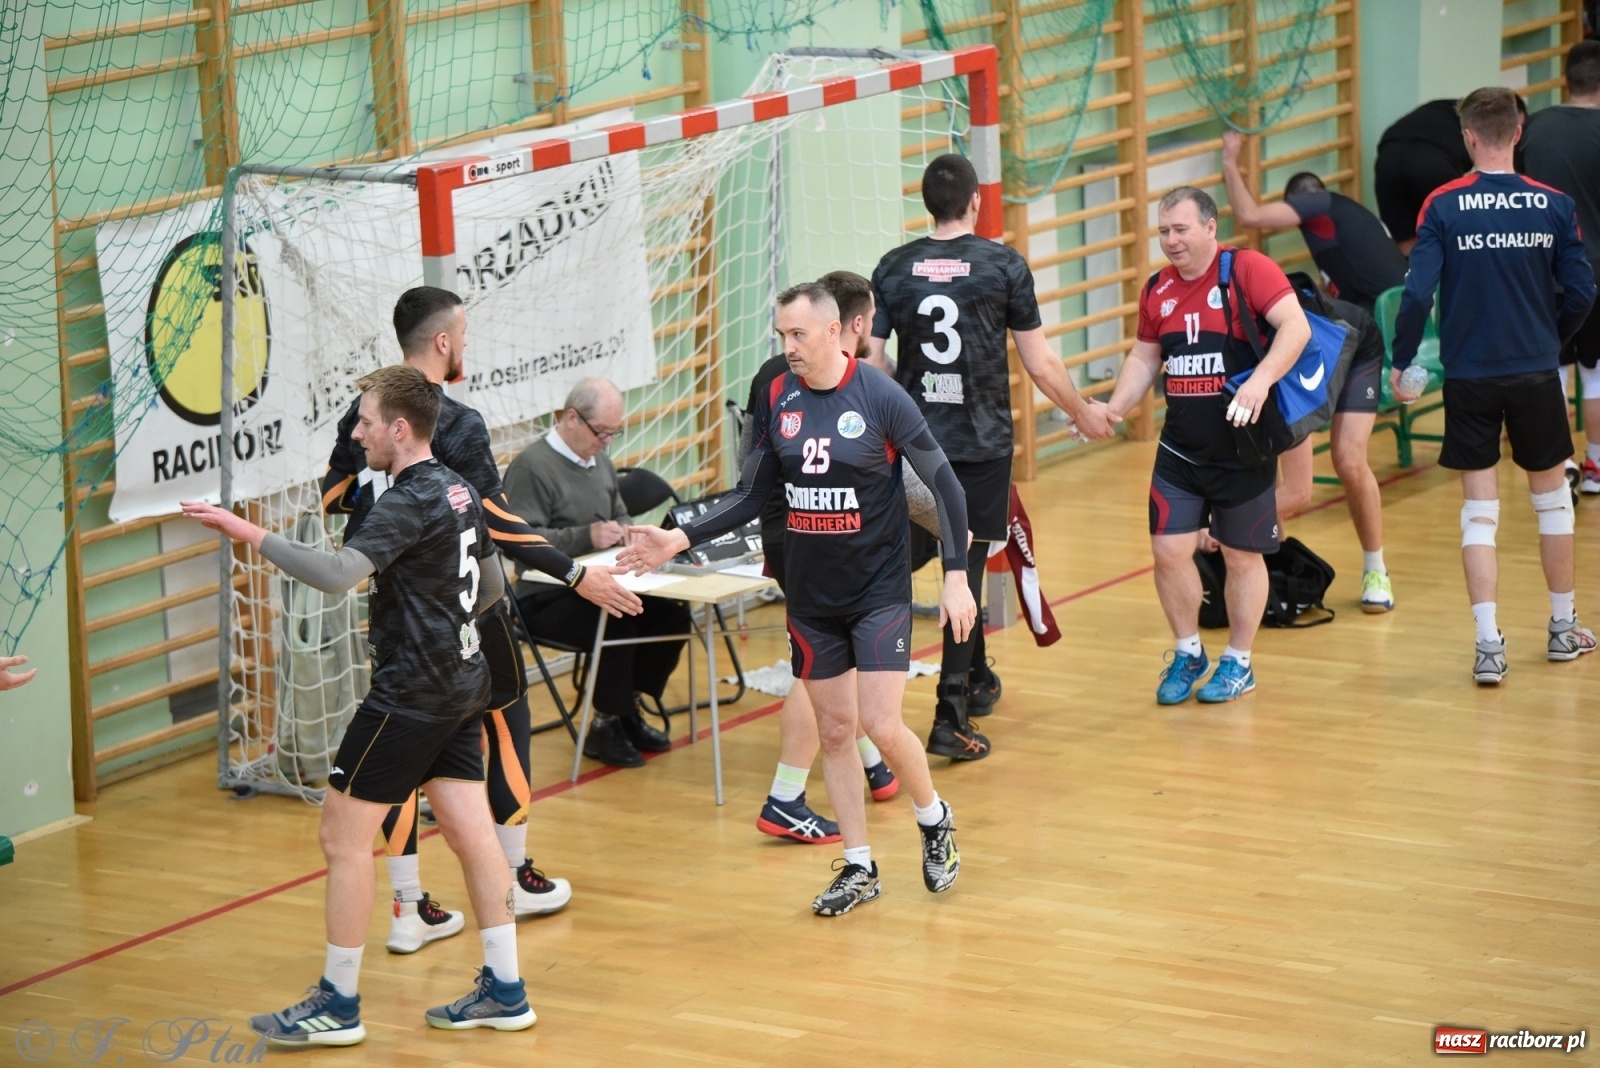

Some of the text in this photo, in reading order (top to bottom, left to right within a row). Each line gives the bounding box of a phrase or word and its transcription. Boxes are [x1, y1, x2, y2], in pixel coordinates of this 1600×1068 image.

[1458, 192, 1548, 211] IMPACTO
[1457, 233, 1553, 250] LKS CHAŁUPKI
[917, 265, 965, 274] PIWIARNIA
[917, 295, 962, 364] 3
[1184, 313, 1200, 345] 11
[152, 419, 285, 484] RACIÓRZ
[801, 437, 831, 475] 25
[785, 482, 859, 510] OMERTA
[786, 512, 862, 532] NORTHERN
[459, 527, 481, 613] 5
